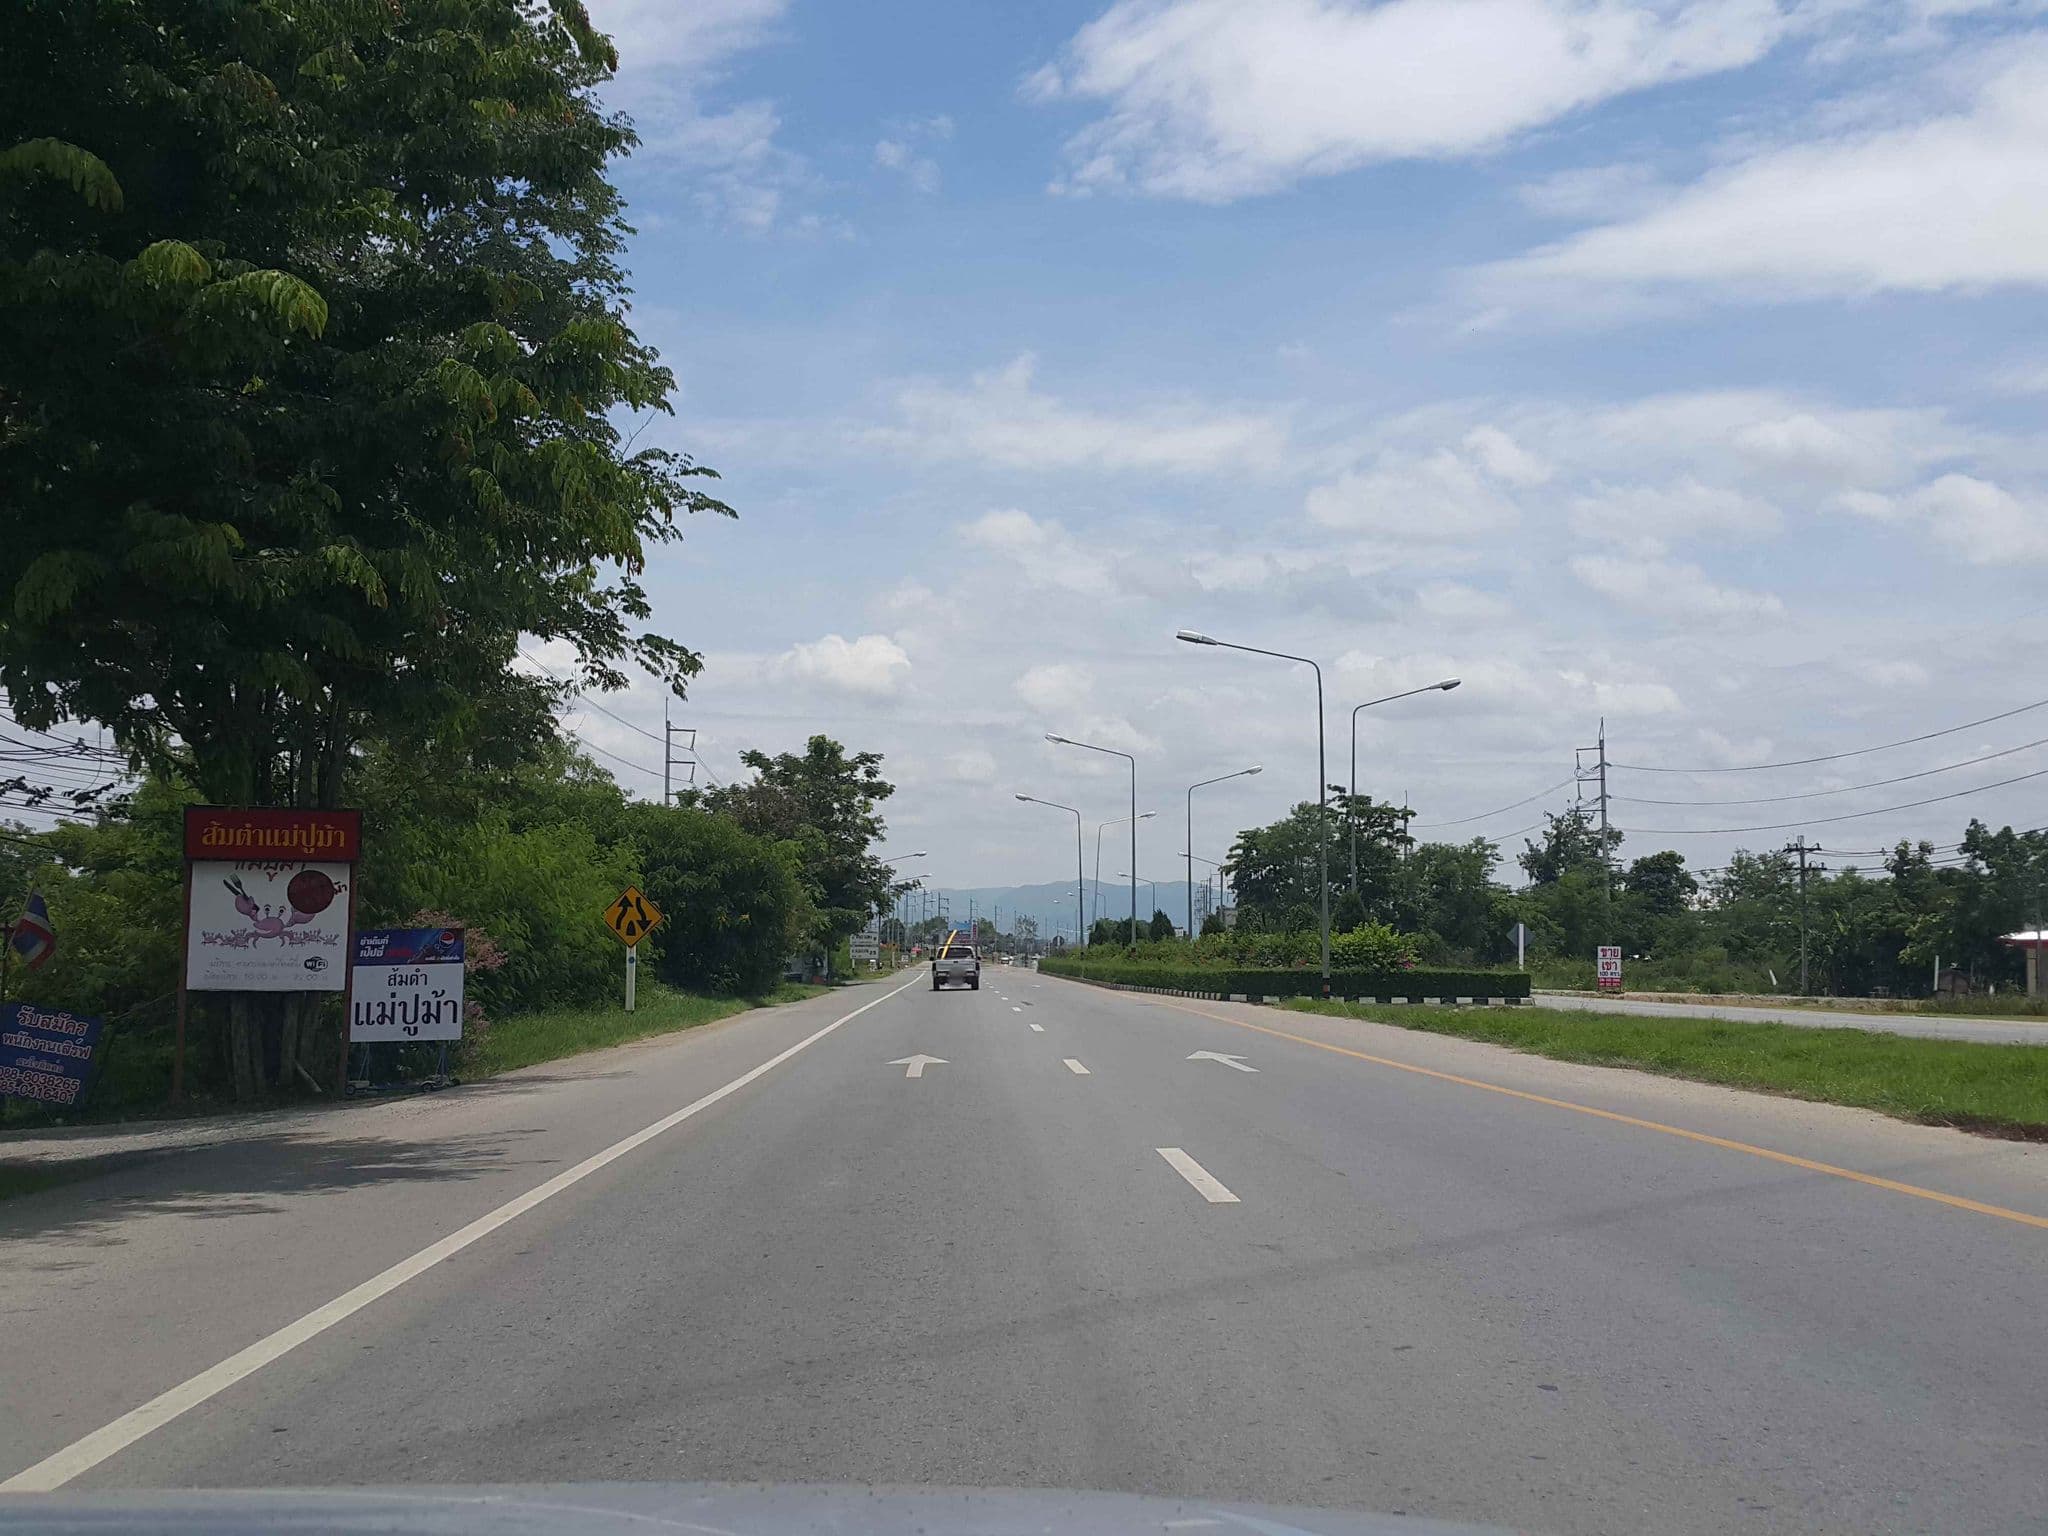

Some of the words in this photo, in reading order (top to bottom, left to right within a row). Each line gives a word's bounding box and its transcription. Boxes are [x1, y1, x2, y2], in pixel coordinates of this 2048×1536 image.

[202, 820, 346, 854] ส้มตำแม่ปูม้า
[1600, 947, 1619, 958] ขาย
[17, 1005, 89, 1036] รับสมัคร
[354, 989, 458, 1036] แม่ปูม้า
[3, 1031, 92, 1060] พนักงานเสิร์ฟ
